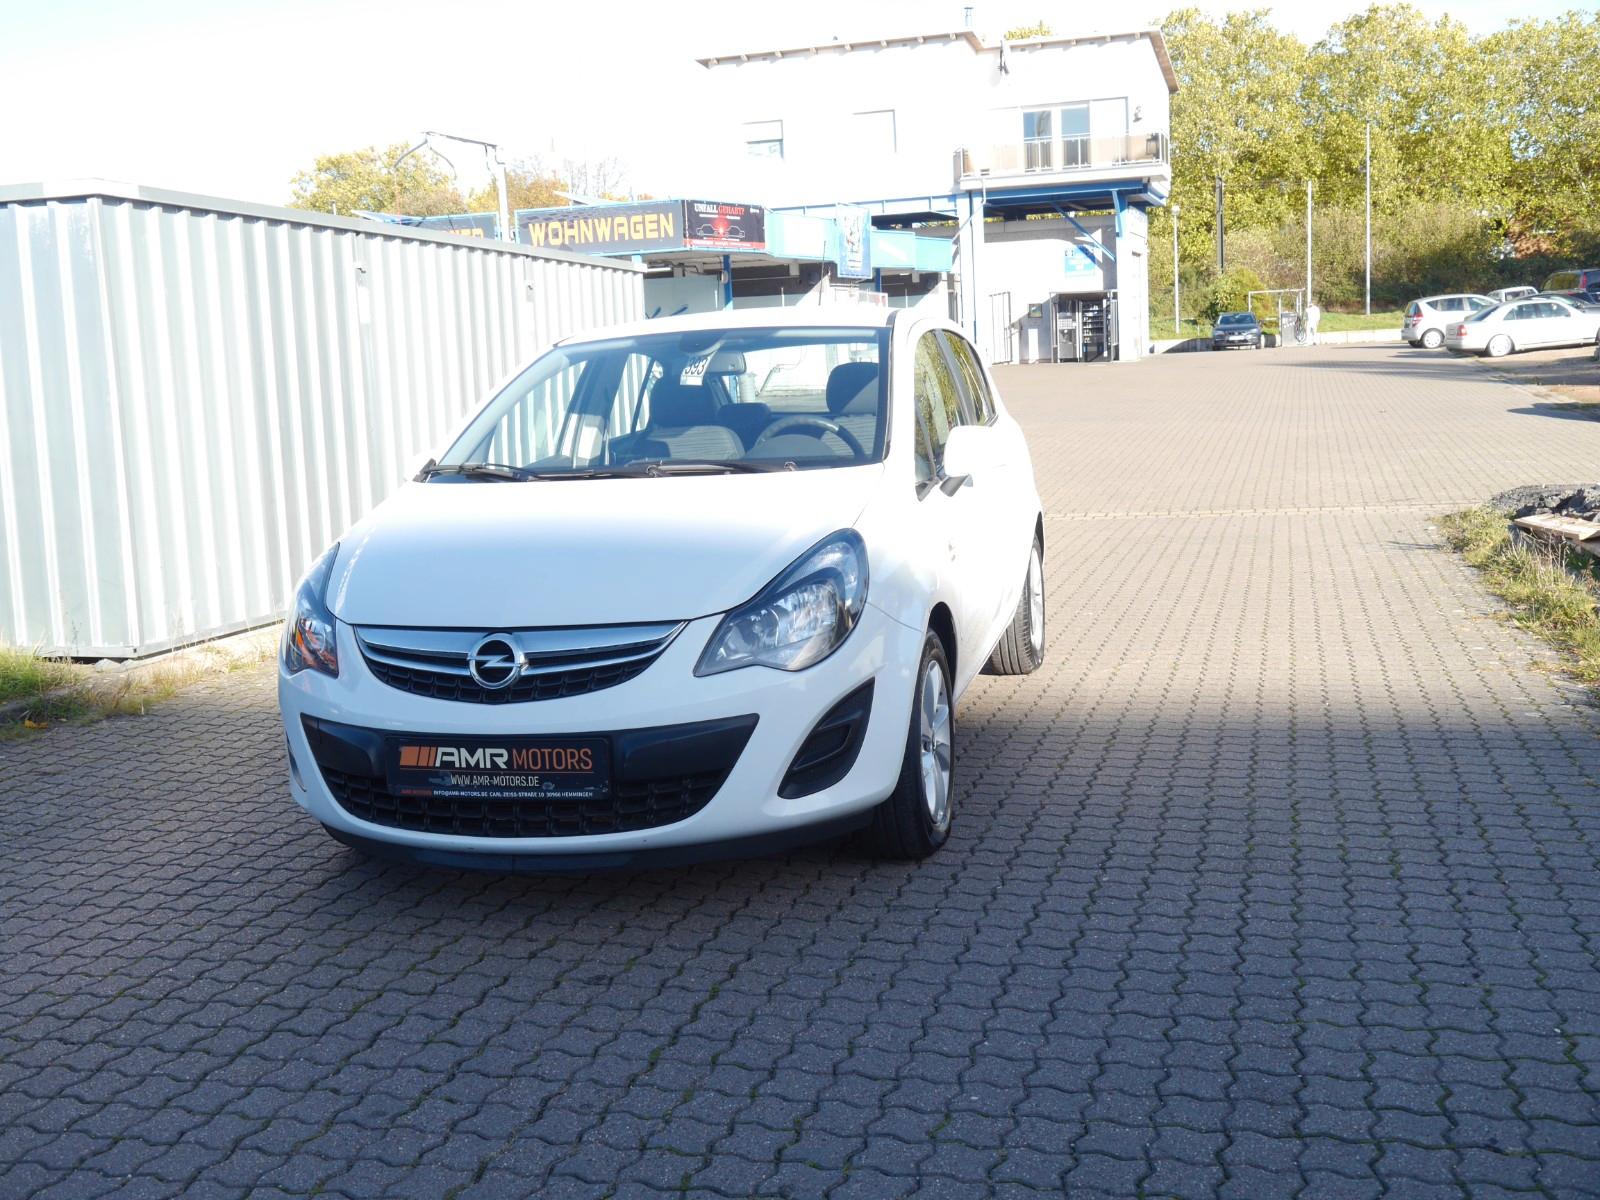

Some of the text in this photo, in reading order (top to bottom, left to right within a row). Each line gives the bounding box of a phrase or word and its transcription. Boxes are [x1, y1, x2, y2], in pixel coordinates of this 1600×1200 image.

[694, 203, 718, 213] UNFALL
[528, 213, 675, 247] WOHNWAGEN
[435, 747, 593, 770] AMR MOTORS
[450, 774, 540, 787] WWW.AMR-MOTORS.DE
